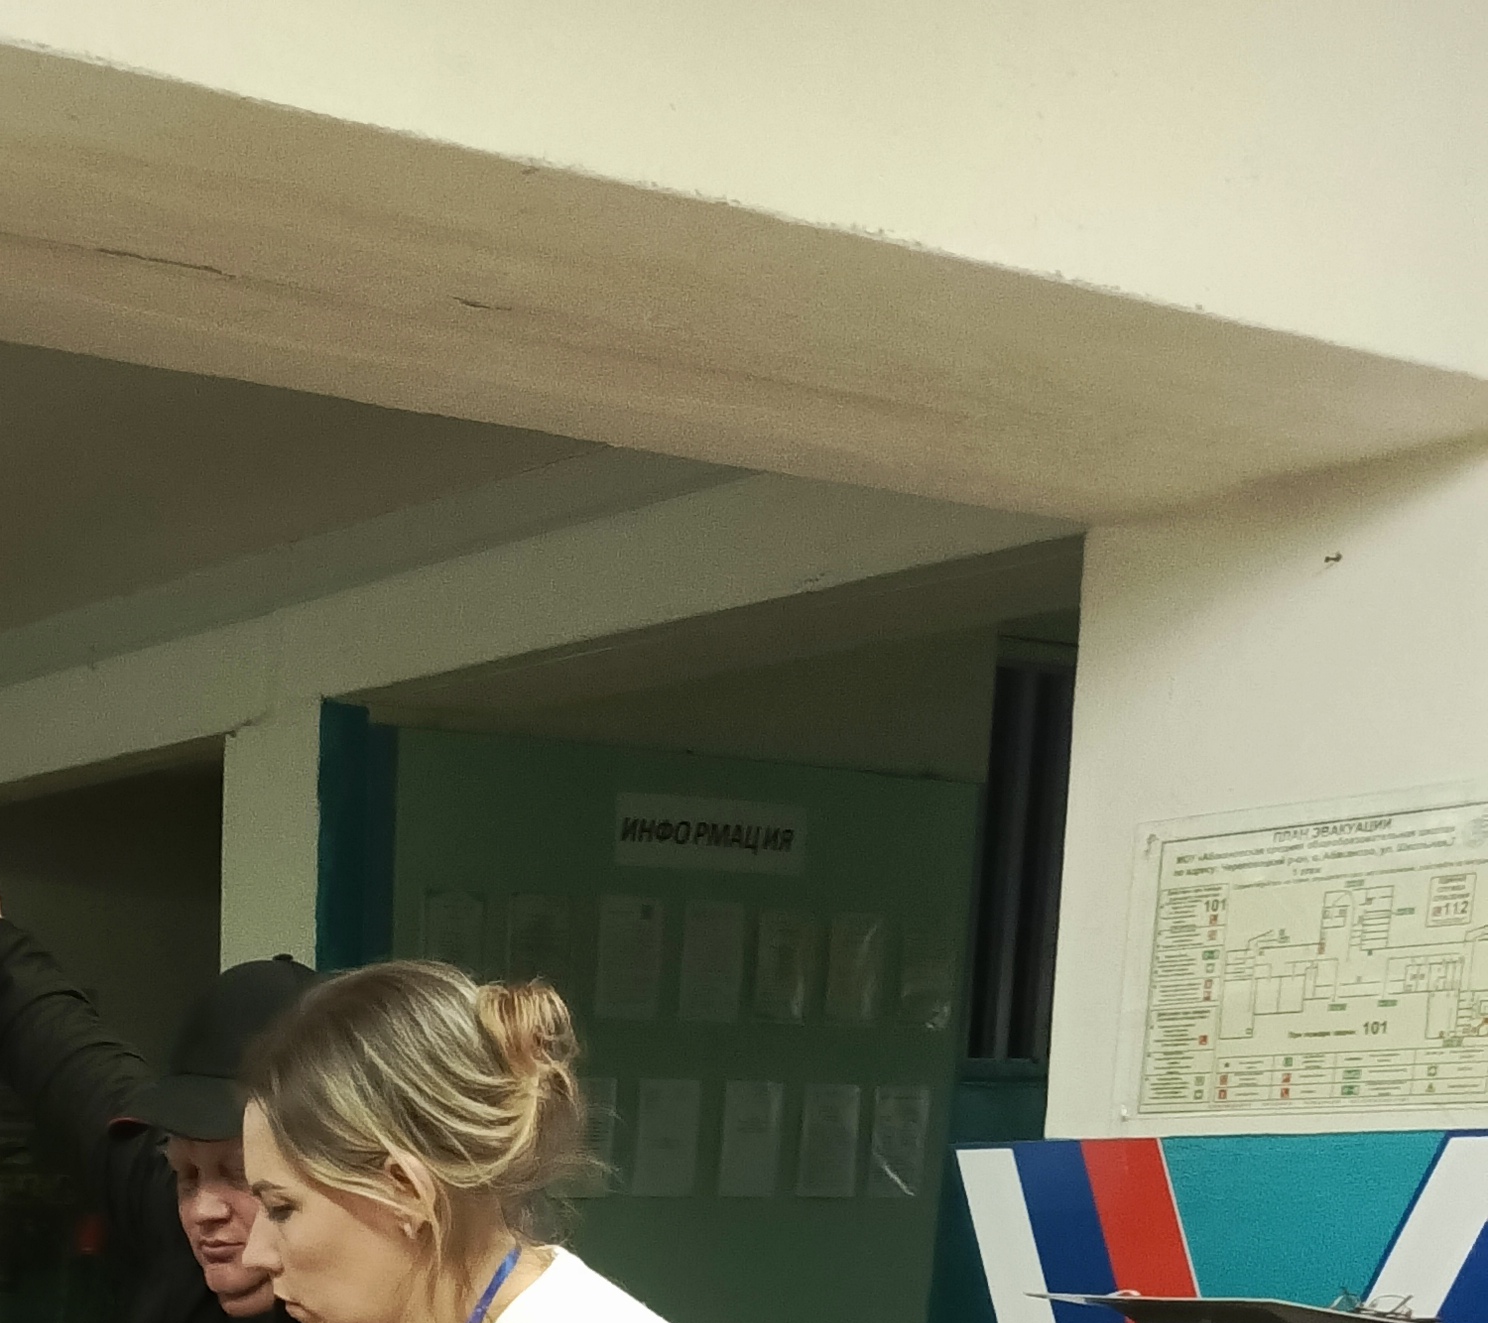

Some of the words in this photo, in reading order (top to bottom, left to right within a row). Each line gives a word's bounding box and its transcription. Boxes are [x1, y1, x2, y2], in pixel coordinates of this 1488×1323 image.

[621, 816, 795, 856] ИНФОРМАЦИЯ
[1273, 827, 1310, 843] ПЛАН
[1313, 818, 1393, 839] ЭВАКУАЦИИ
[1204, 898, 1227, 913] 101
[1444, 900, 1469, 916] 112
[1362, 1020, 1388, 1036] 101
